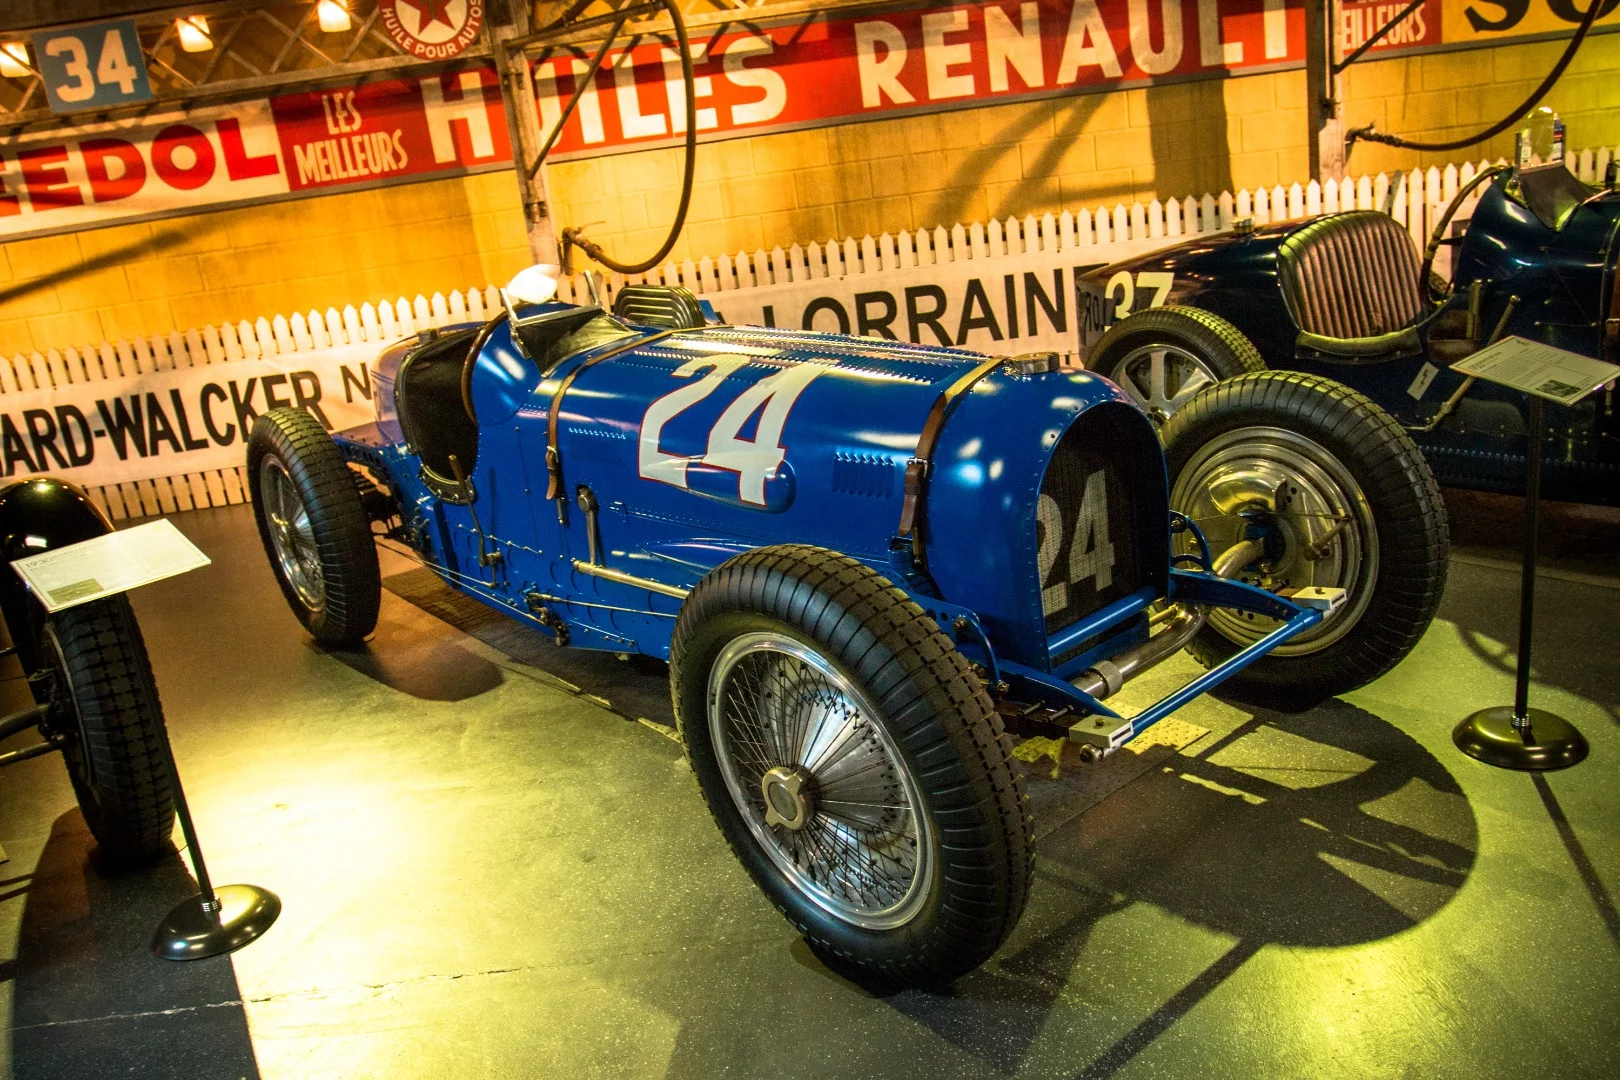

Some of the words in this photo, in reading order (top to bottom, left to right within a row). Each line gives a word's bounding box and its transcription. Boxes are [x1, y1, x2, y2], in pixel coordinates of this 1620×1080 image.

[382, 8, 414, 50] HUILE
[414, 43, 458, 58] POUR
[1341, 3, 1426, 51] EILLEURS
[45, 28, 137, 103] 34
[322, 90, 362, 135] LES
[293, 129, 408, 186] MEILLEURS
[763, 262, 1109, 347] ORRAIN
[1104, 270, 1174, 333] 37
[0, 371, 334, 478] ARD-WALCKER
[638, 353, 841, 508] 24
[1037, 468, 1116, 618] 24
